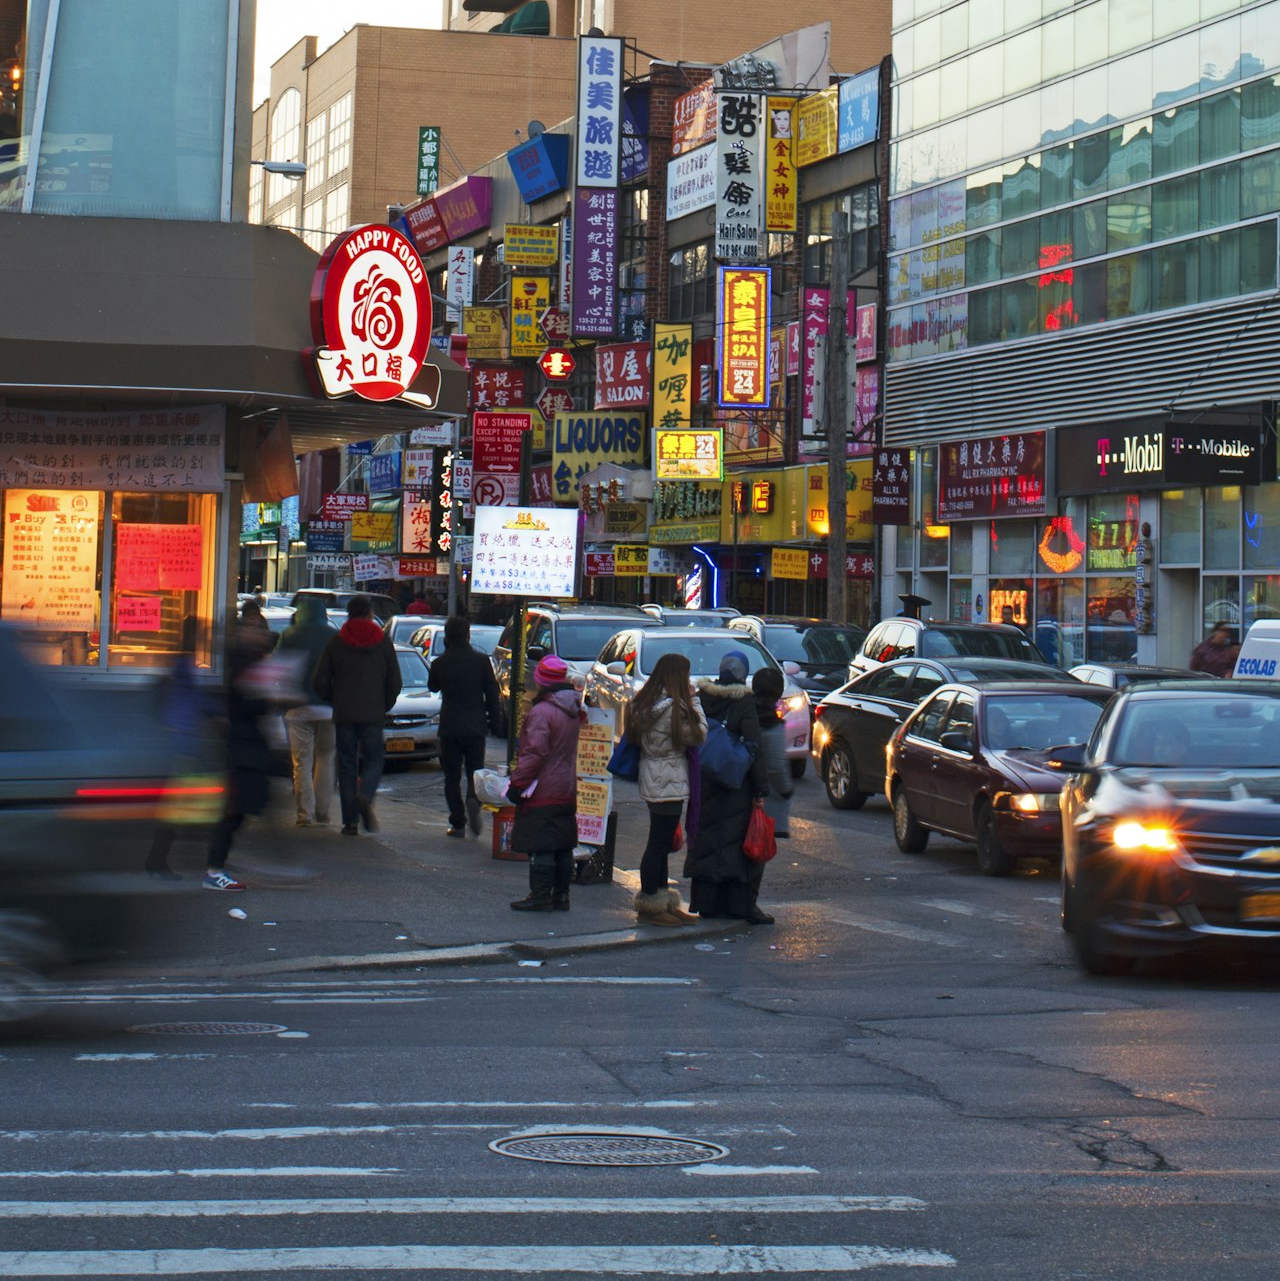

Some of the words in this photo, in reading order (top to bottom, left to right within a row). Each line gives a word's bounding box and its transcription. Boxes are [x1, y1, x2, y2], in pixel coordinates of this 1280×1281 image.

[584, 45, 615, 180] 佳美旅遊
[773, 140, 790, 200] 金女神
[606, 193, 615, 209] NEW
[726, 207, 751, 219] Cool
[605, 211, 615, 249] CENTURY
[719, 223, 737, 240] Hair
[737, 225, 757, 240] Salon
[345, 230, 391, 260] HAPPY
[391, 237, 424, 284] FOOD
[451, 248, 468, 276] 名人
[586, 194, 607, 318] 創世紀美容中心
[605, 251, 614, 284] BEAUTY
[604, 285, 613, 318] CENTER
[732, 279, 757, 333] 泰皇
[731, 344, 757, 358] SPA
[335, 352, 404, 383] 大口福
[733, 369, 754, 377] OPEN
[733, 377, 754, 389] 24
[606, 385, 644, 402] SALON
[477, 418, 489, 427] NO
[491, 418, 528, 428] STANDING
[476, 428, 500, 436] EXCEPT
[555, 417, 641, 454] LIQUORS
[696, 435, 715, 443] OPEN
[696, 442, 715, 453] 24
[882, 485, 893, 495] ALL
[315, 555, 350, 564] TATTOO
[1237, 657, 1277, 677] ECOLAB
